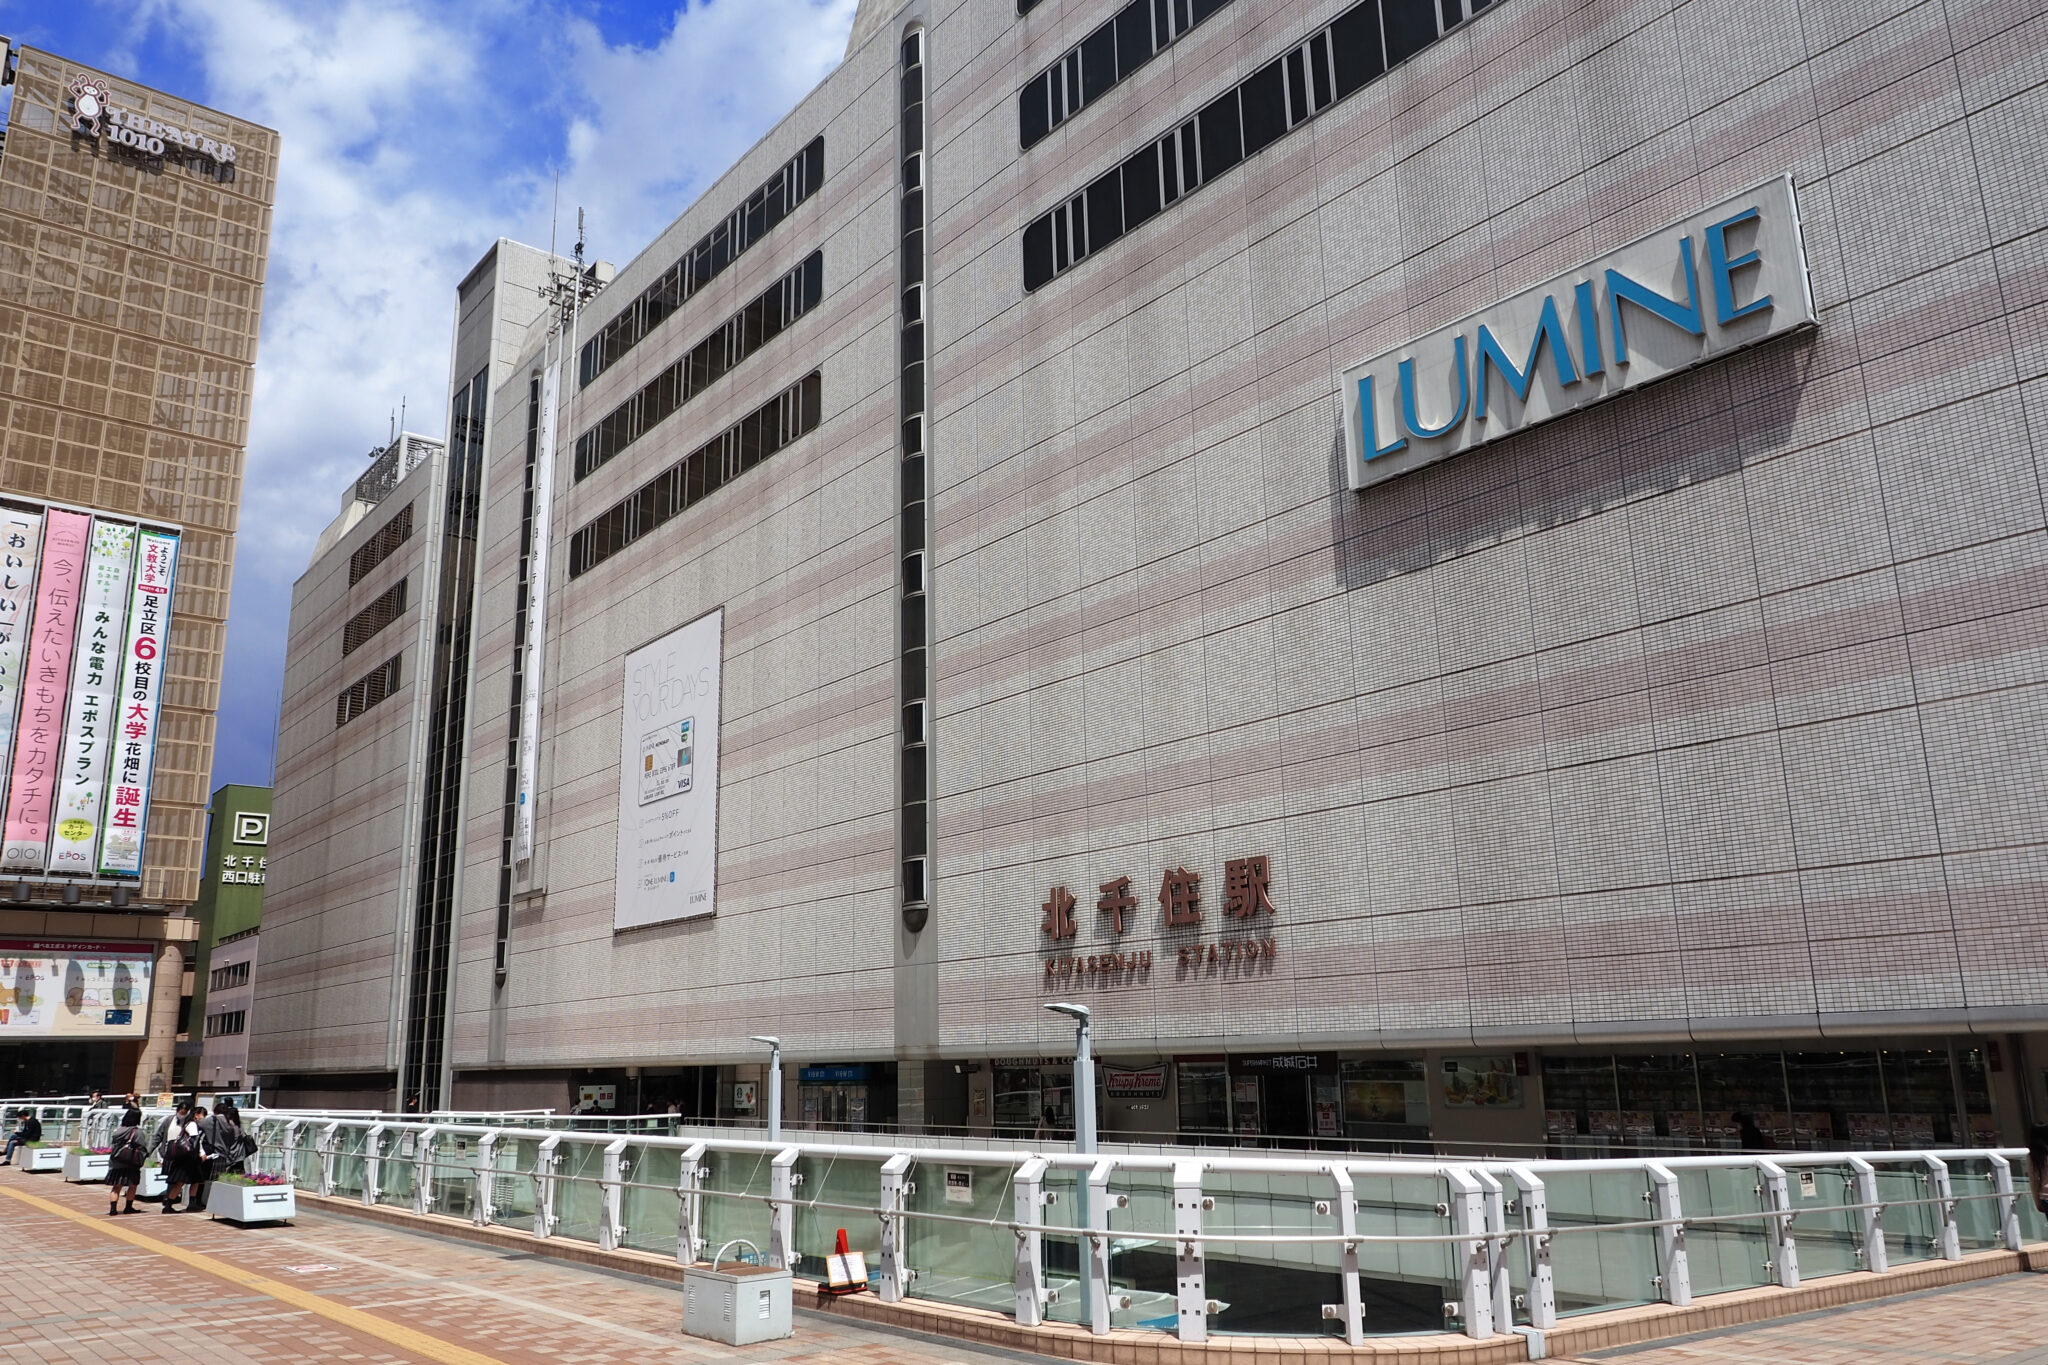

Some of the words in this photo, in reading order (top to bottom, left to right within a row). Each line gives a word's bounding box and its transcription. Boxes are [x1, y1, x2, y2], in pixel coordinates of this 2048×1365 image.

[105, 105, 237, 163] THEATRE
[107, 124, 165, 155] 1010
[1358, 205, 1774, 463] LUMINE
[144, 544, 158, 583] 文教大学
[158, 546, 168, 576] ようこそ
[632, 651, 676, 697] STYLE
[678, 777, 690, 789] VISA
[240, 818, 263, 839] P
[58, 851, 87, 861] EPOS
[222, 871, 266, 885] 西口駐
[1041, 855, 1276, 940] 北千住駅
[1044, 950, 1152, 977] KITASENJU
[1177, 938, 1277, 965] STATION
[994, 1057, 1049, 1066] DOUGHNUTS
[1272, 1056, 1317, 1069] 成城石井
[1108, 1073, 1135, 1089] Krispy
[1134, 1073, 1161, 1089] Kreme
